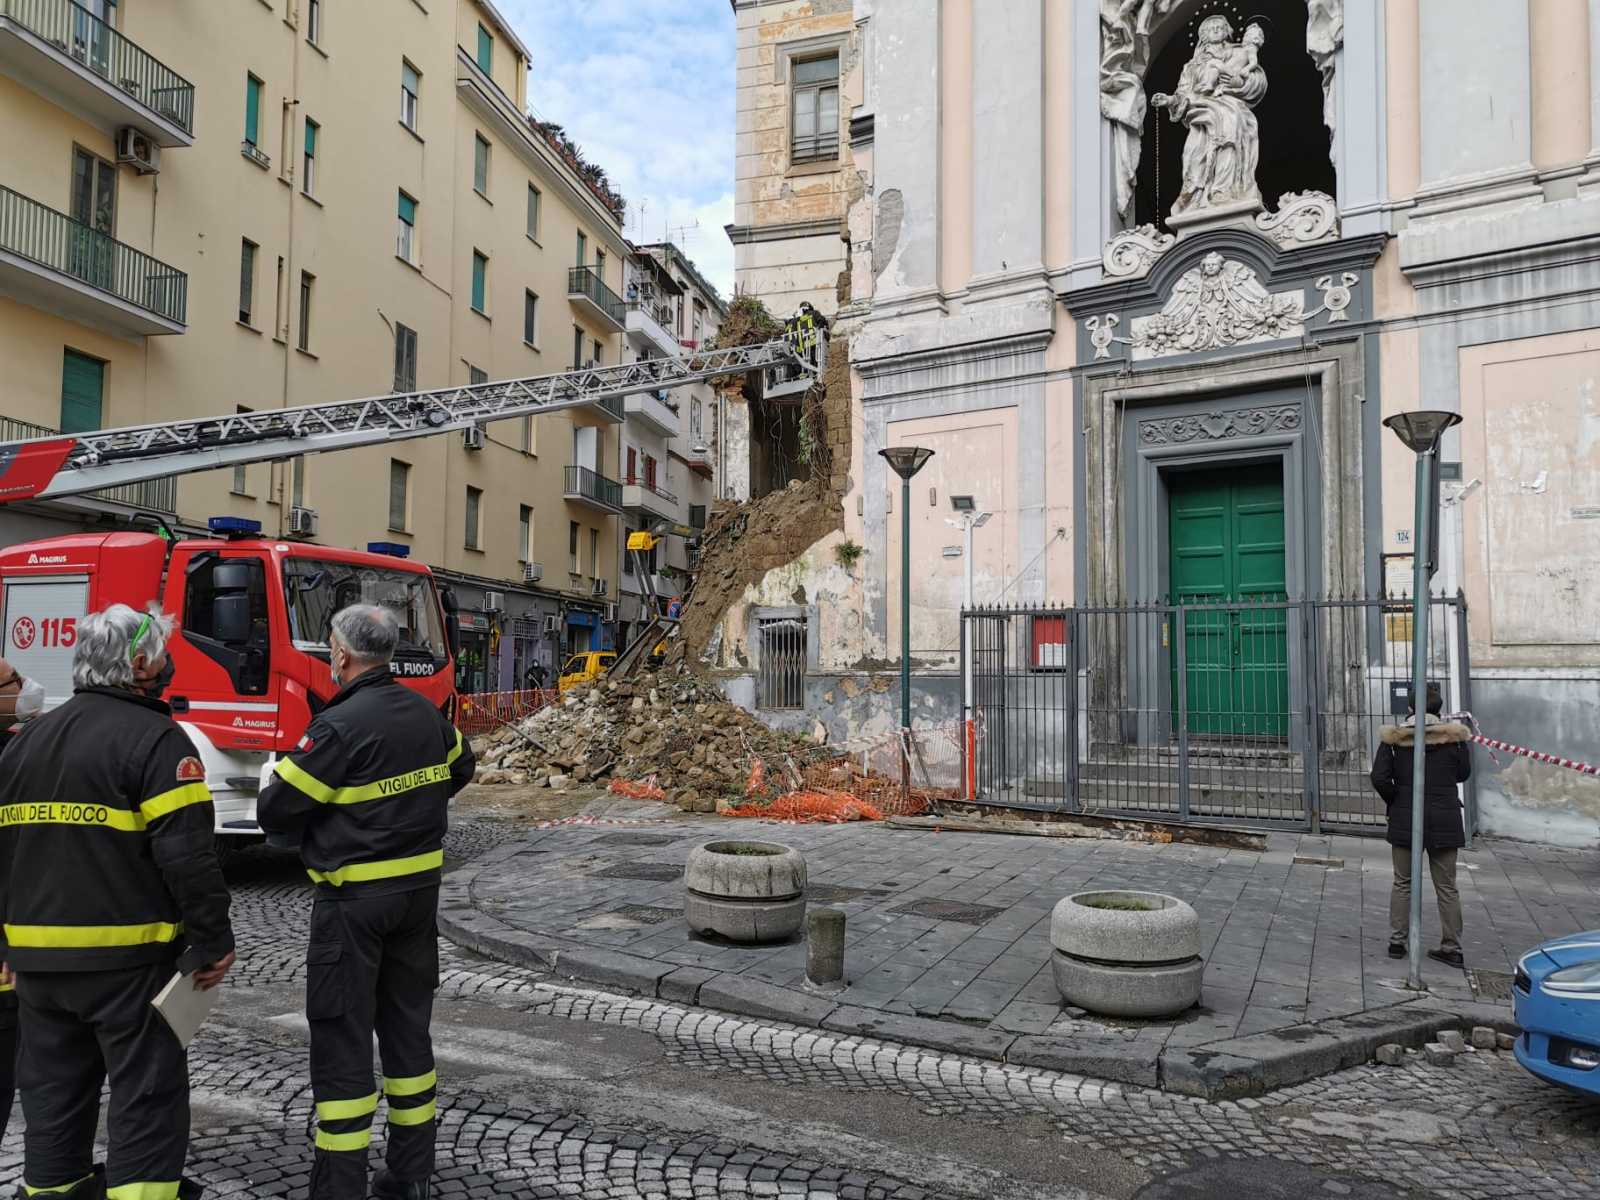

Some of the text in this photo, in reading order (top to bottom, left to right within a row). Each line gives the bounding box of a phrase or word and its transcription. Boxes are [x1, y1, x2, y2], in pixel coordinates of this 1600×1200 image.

[39, 555, 67, 564] MAGIRUS
[41, 618, 77, 647] 115
[389, 662, 434, 675] EL FUOCO
[245, 720, 276, 728] MAGIRUS
[378, 774, 412, 794] VIGILI
[413, 770, 431, 785] DEL
[29, 805, 56, 820] DEL
[61, 805, 108, 823] FUOCO
